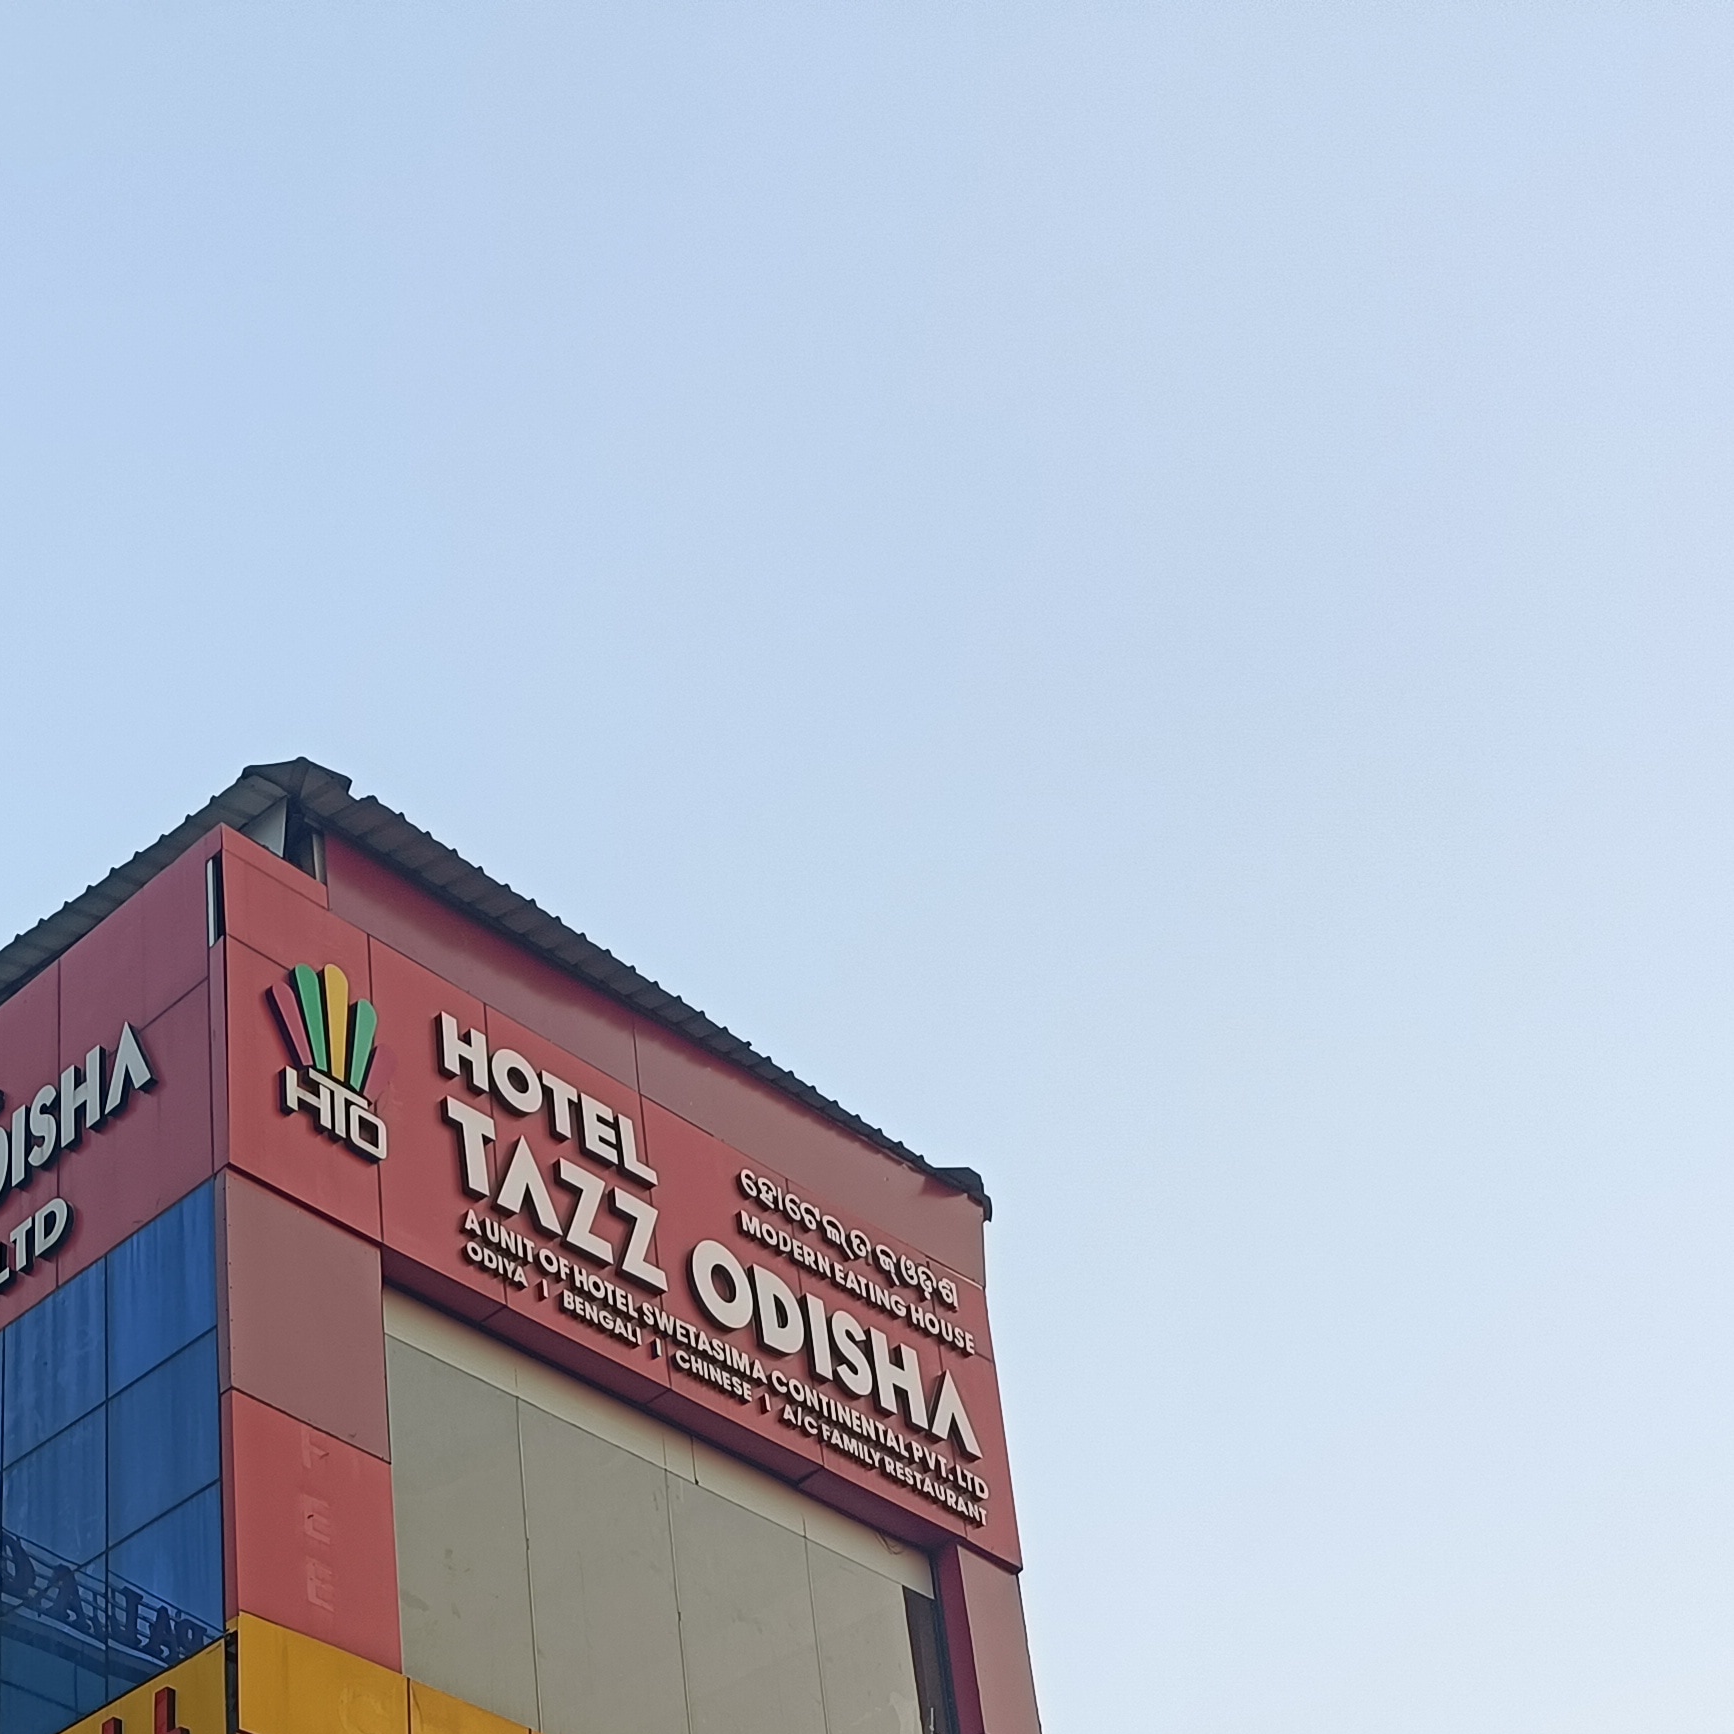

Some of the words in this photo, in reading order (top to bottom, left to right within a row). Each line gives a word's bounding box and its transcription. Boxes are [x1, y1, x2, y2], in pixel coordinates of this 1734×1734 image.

[285, 1065, 387, 1160] HTO
[440, 1011, 657, 1186] HOTEL
[448, 1097, 667, 1291] TAZZ
[464, 1209, 481, 1236] A
[484, 1217, 535, 1262] UNIT
[539, 1248, 570, 1280] OF
[573, 1265, 638, 1317] HOTEL
[642, 1302, 767, 1384] SWETASIMA
[772, 1370, 908, 1458] CONTINENTAL
[911, 1440, 954, 1481] PVT.
[956, 1465, 989, 1499] LTD
[692, 1240, 982, 1458] ODISHA
[740, 1210, 831, 1277] MODERN
[834, 1264, 906, 1317] EATING
[910, 1303, 974, 1354] HOUSE
[466, 1242, 527, 1287] ODIYA
[564, 1290, 642, 1345] BENGALI
[675, 1351, 752, 1401] CHINESE
[822, 1424, 881, 1468] FAMILY
[885, 1456, 987, 1526] RESTAURANT
